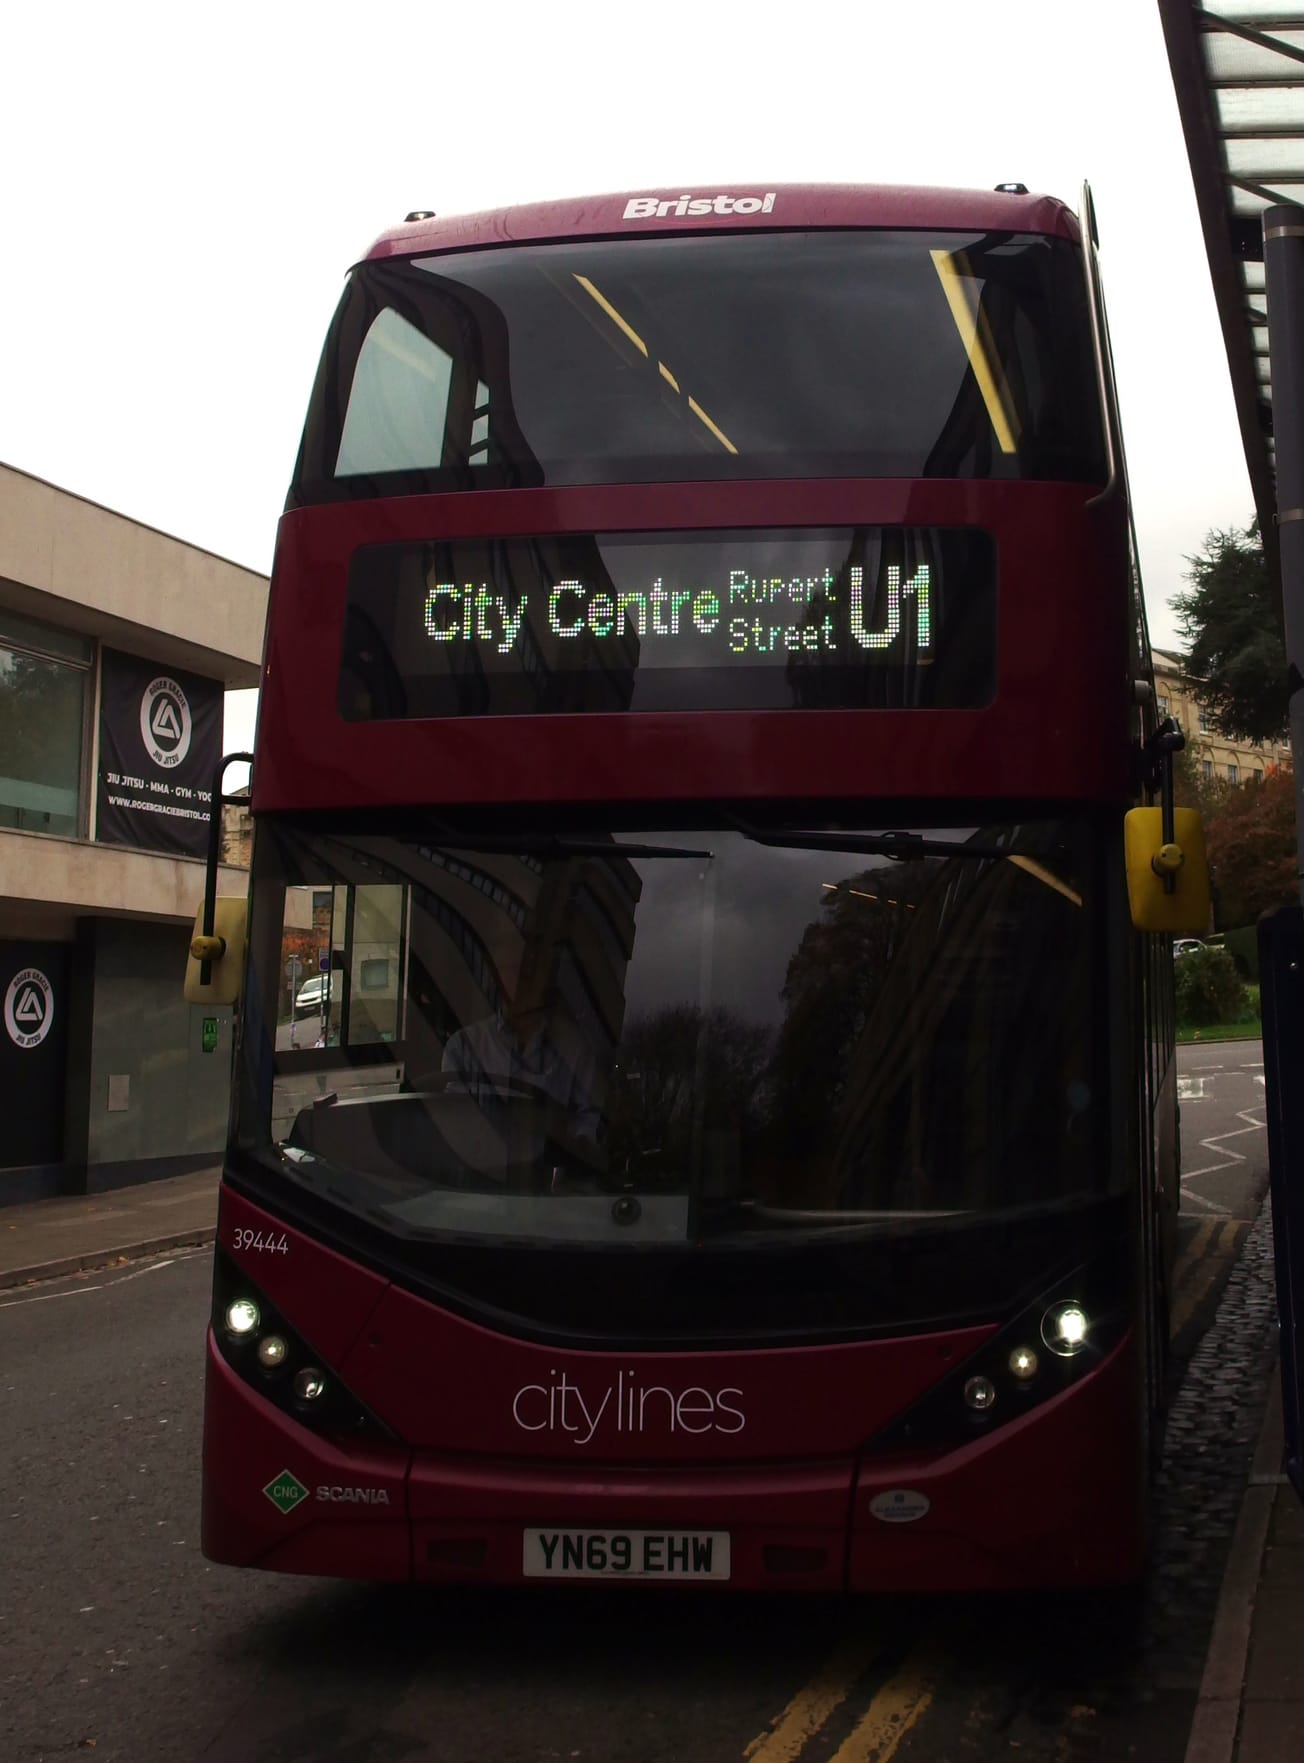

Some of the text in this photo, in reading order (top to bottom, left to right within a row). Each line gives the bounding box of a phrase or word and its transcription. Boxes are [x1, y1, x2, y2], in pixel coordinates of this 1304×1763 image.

[622, 193, 777, 220] Bristol
[729, 567, 837, 603] Rupert
[424, 577, 720, 653] City Centre
[850, 564, 931, 648] U1
[729, 615, 837, 652] Street
[107, 772, 120, 784] JIU
[121, 775, 145, 790] JITSU
[150, 781, 170, 795] MMA
[175, 786, 192, 799] GYM
[108, 795, 211, 822] WWW.ROGERGRACIEBRISTOL.CO
[232, 1228, 289, 1255] 39444
[513, 1368, 745, 1444] citylines
[272, 1485, 298, 1499] CNG
[315, 1486, 390, 1505] SCANIA
[539, 1534, 713, 1572] YN69 EHW
